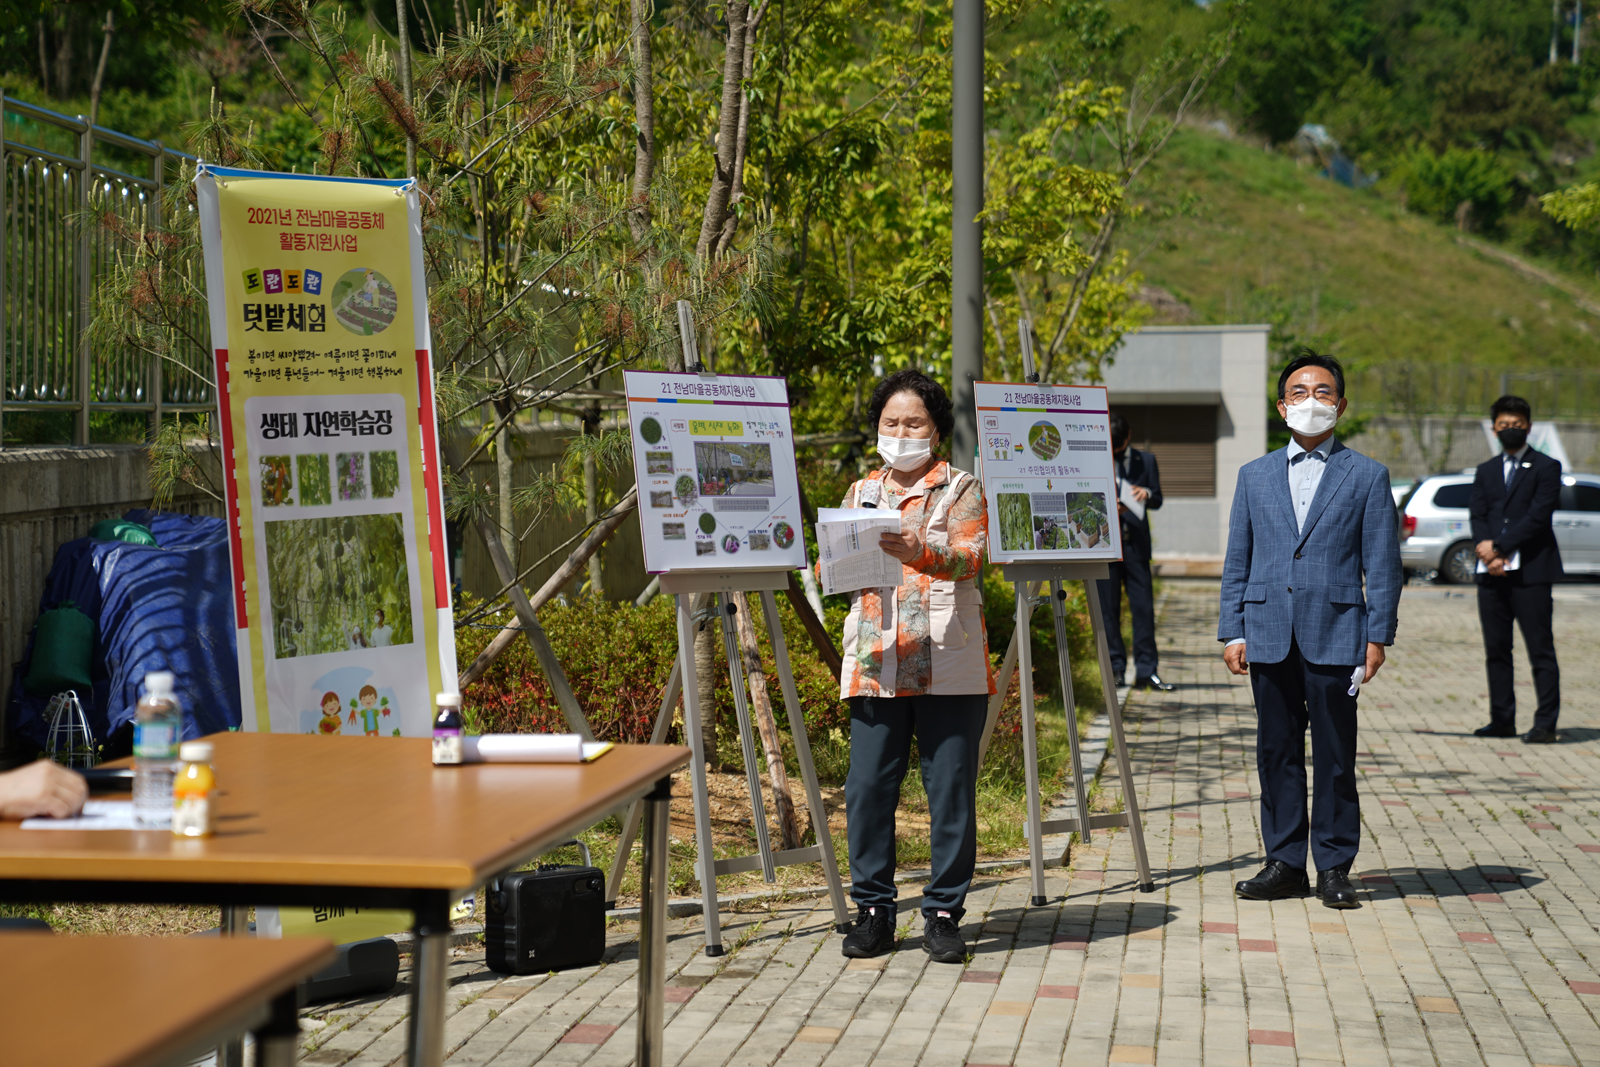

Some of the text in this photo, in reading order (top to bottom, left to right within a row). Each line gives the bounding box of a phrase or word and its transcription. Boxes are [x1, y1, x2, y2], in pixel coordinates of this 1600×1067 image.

[247, 207, 385, 230] 2021년 전남마을공동체
[279, 232, 358, 252] 활동지원사업
[245, 271, 321, 292] 도란도란
[243, 303, 326, 333] 텃밭체험
[248, 349, 275, 364] 봄이면
[324, 349, 359, 363] 여름이면
[661, 382, 756, 398] 21 전남마을공동체지원사업
[1004, 392, 1082, 406] 21 전남마을공동체지원사업
[259, 409, 393, 439] 생태 자연학습장
